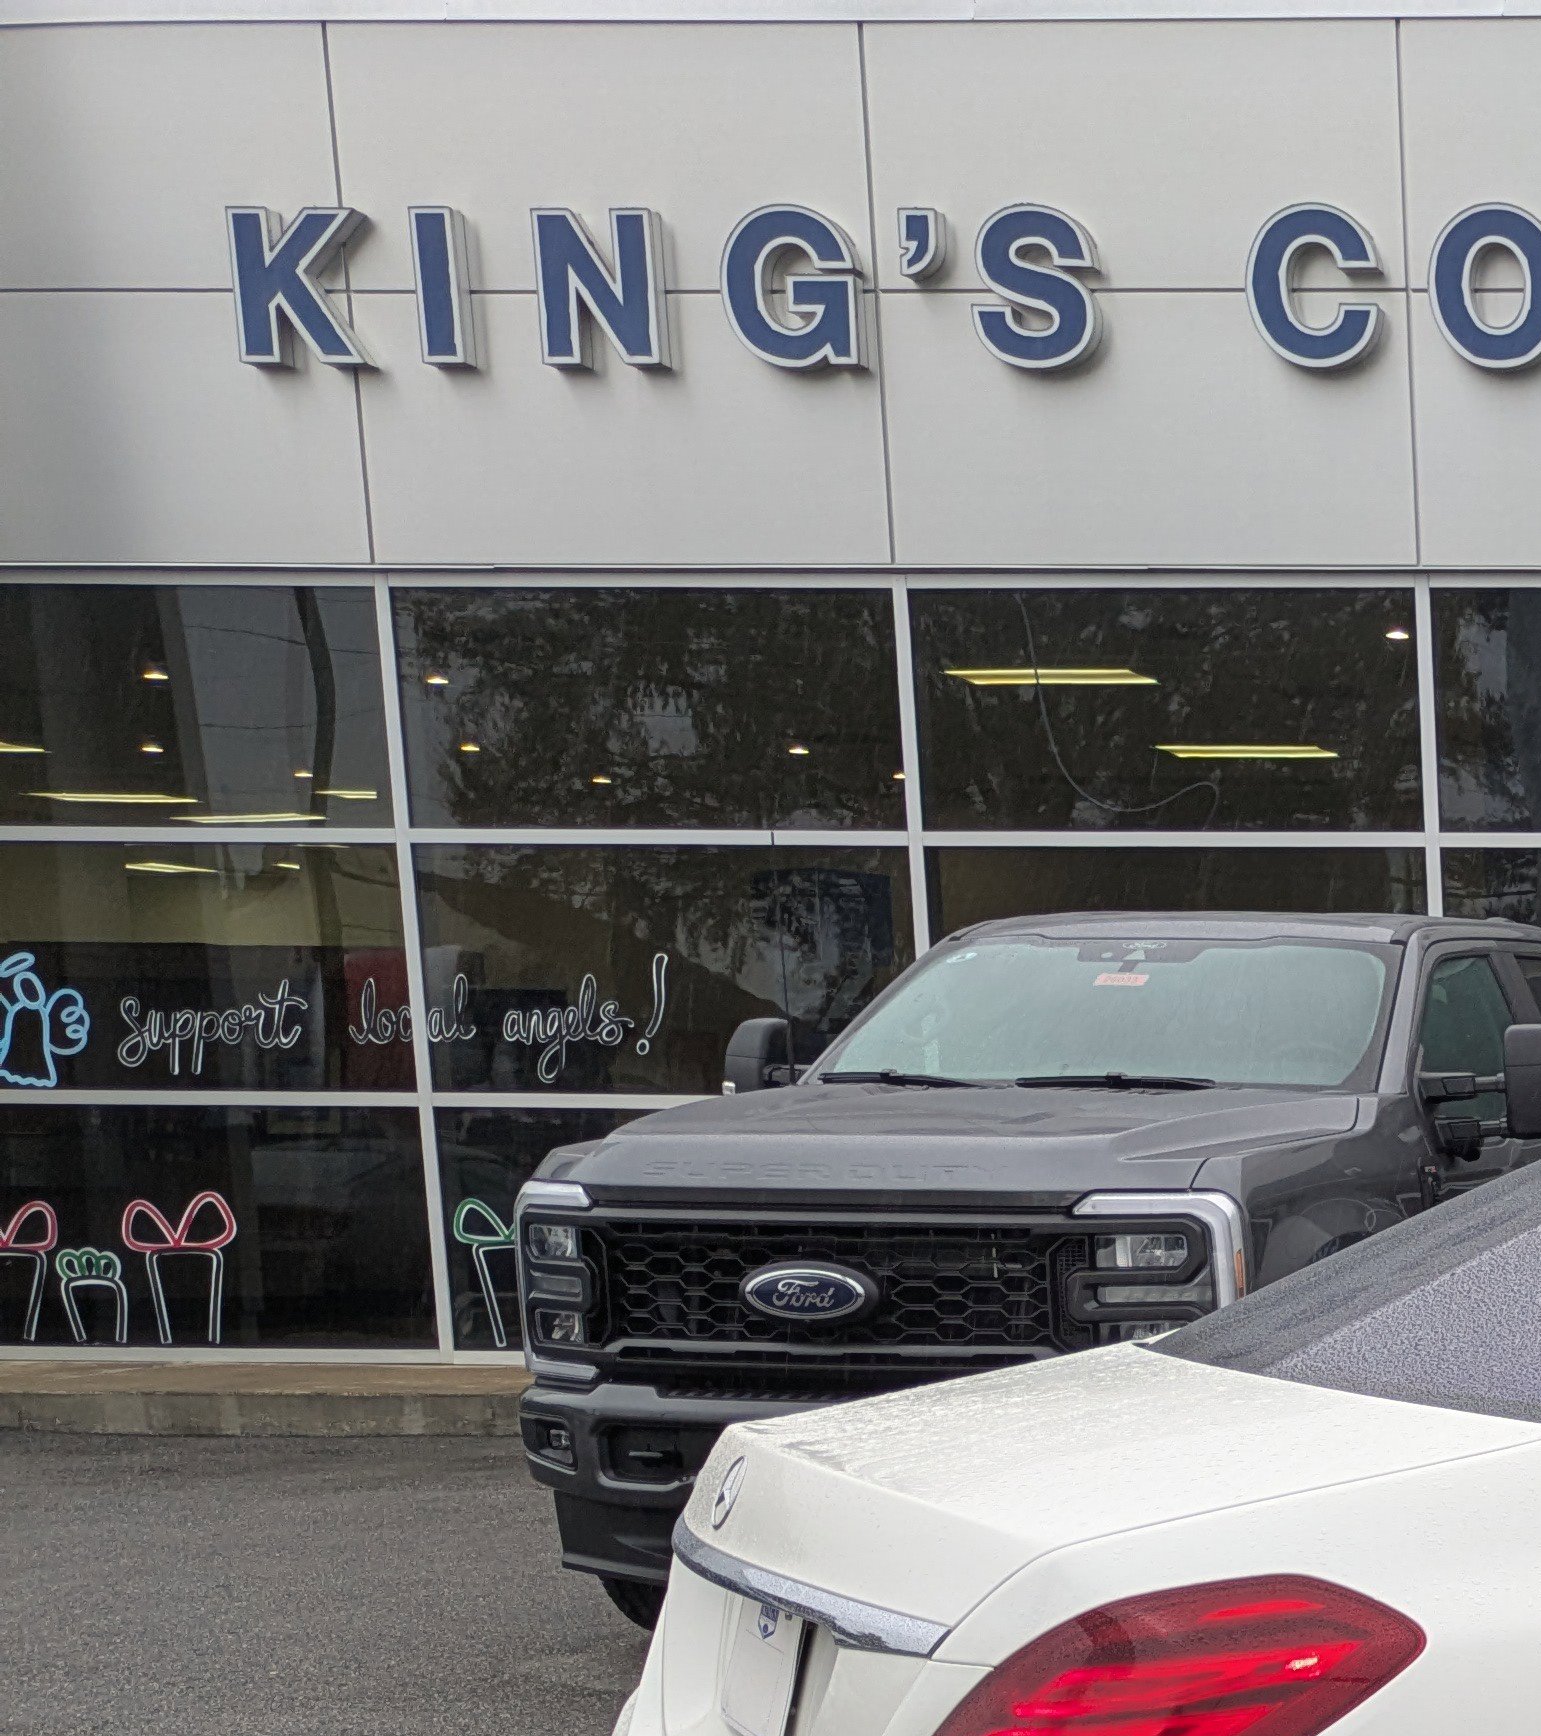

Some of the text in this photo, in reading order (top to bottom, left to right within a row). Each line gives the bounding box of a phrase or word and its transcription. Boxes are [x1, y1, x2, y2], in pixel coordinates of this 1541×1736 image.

[225, 203, 1104, 370] KING'S
[348, 973, 477, 1046] local
[643, 1161, 831, 1181] SUPER
[772, 1279, 836, 1308] Ford
